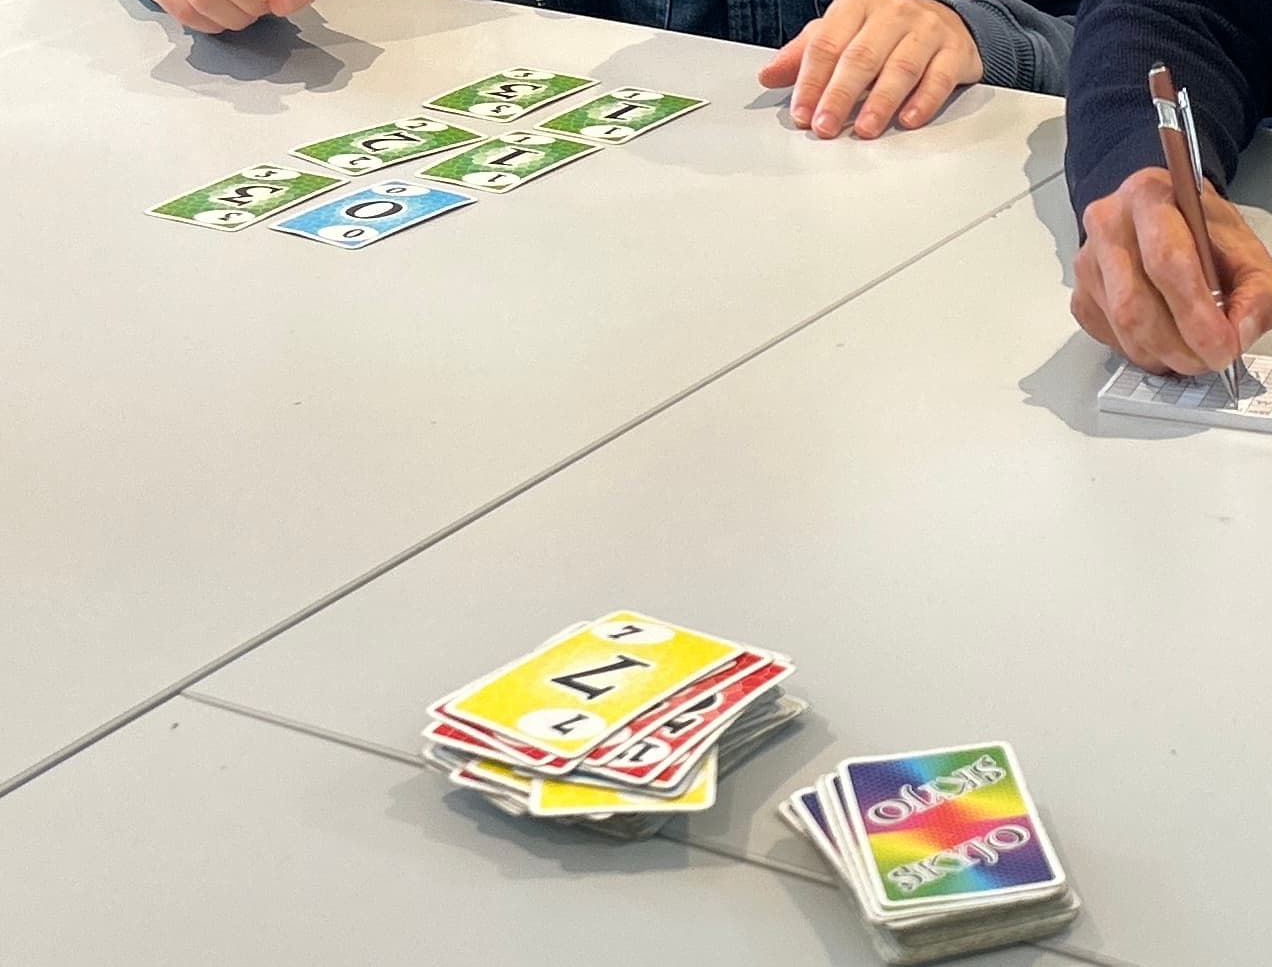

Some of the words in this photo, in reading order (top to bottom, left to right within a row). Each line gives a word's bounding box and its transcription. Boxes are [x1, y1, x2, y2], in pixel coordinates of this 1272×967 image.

[604, 103, 651, 120] 1
[362, 132, 421, 152] 2
[488, 147, 539, 166] 1
[345, 200, 404, 219] 0
[551, 655, 651, 700] 7
[552, 714, 590, 735] 7
[867, 754, 1007, 825] SKYJO
[887, 824, 1031, 893] SKYJO
